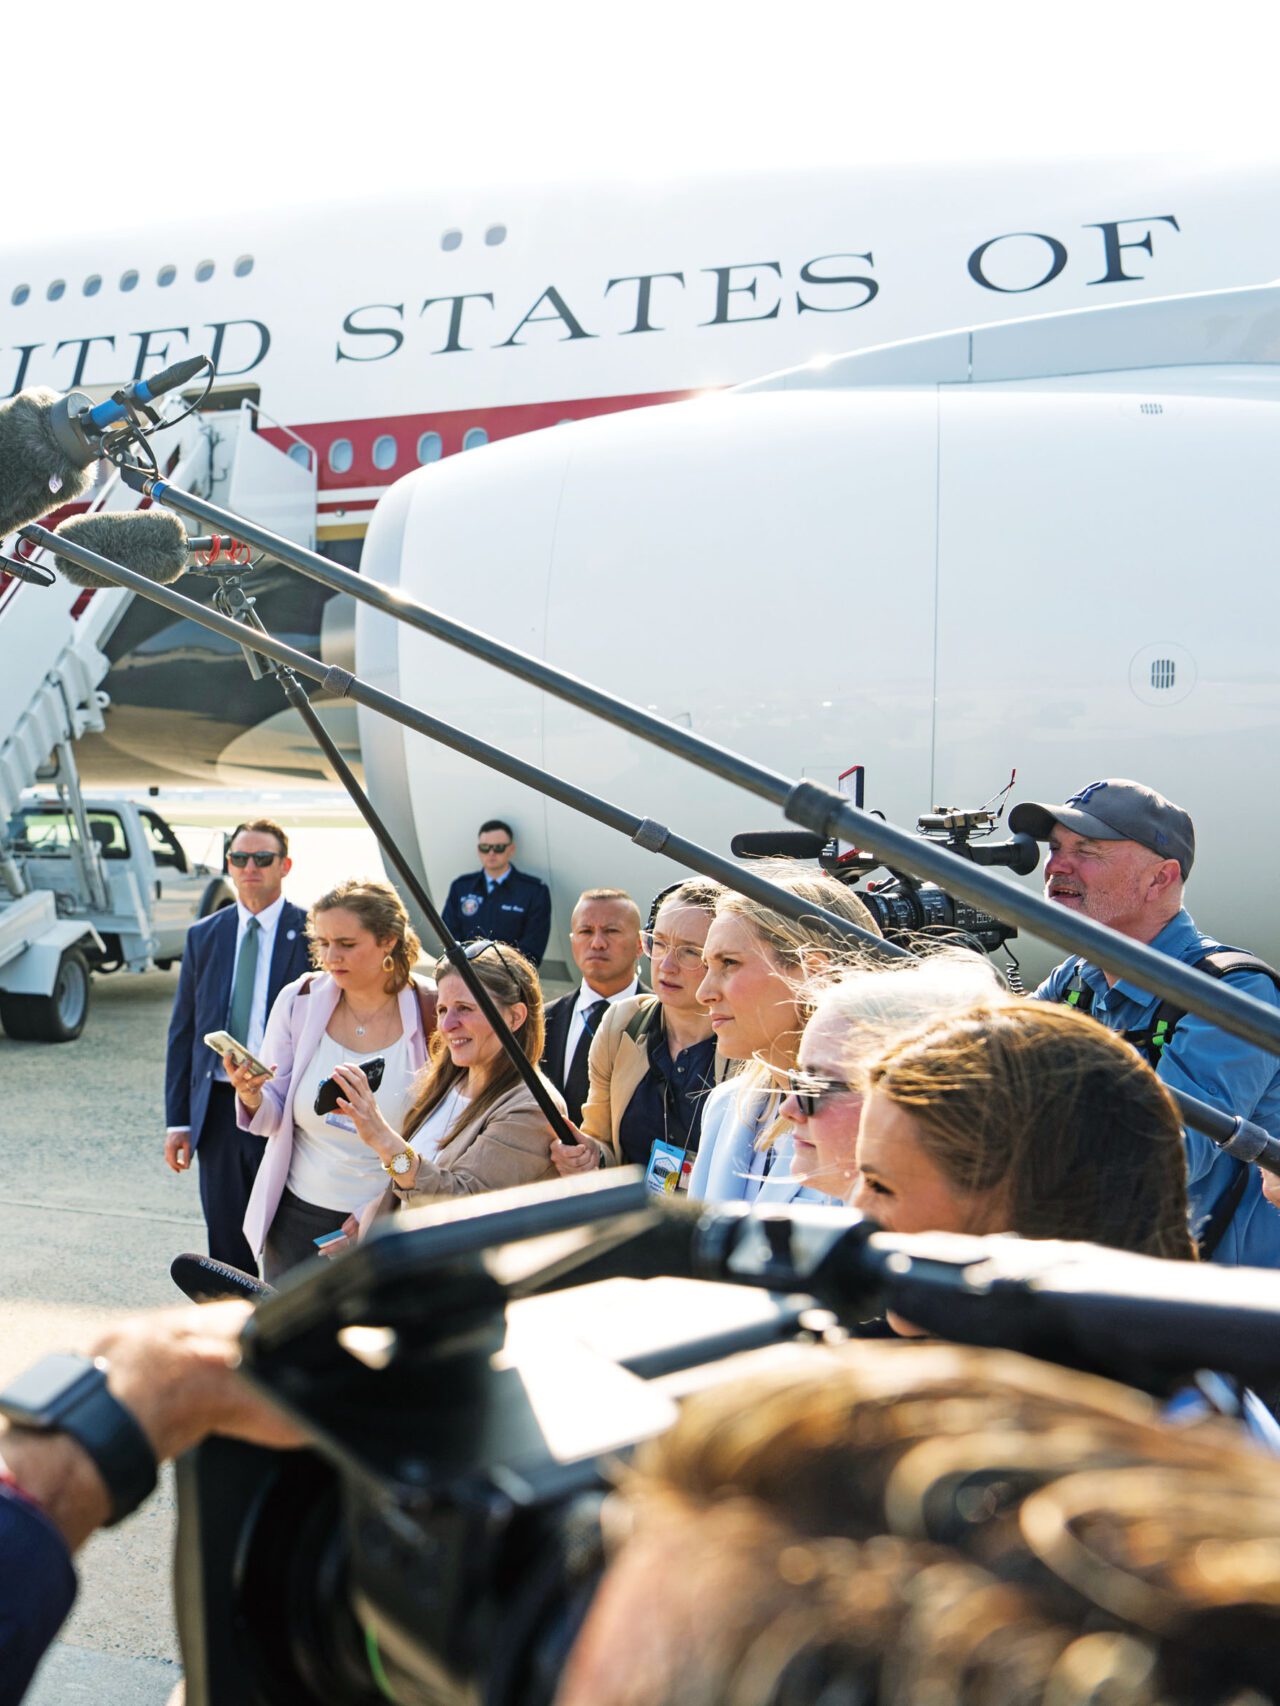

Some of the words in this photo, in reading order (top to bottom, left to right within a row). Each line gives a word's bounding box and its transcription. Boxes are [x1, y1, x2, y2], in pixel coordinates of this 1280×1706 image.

[336, 251, 880, 363] STATES
[967, 214, 1181, 294] OF
[199, 1259, 260, 1293] SENNHEISER
